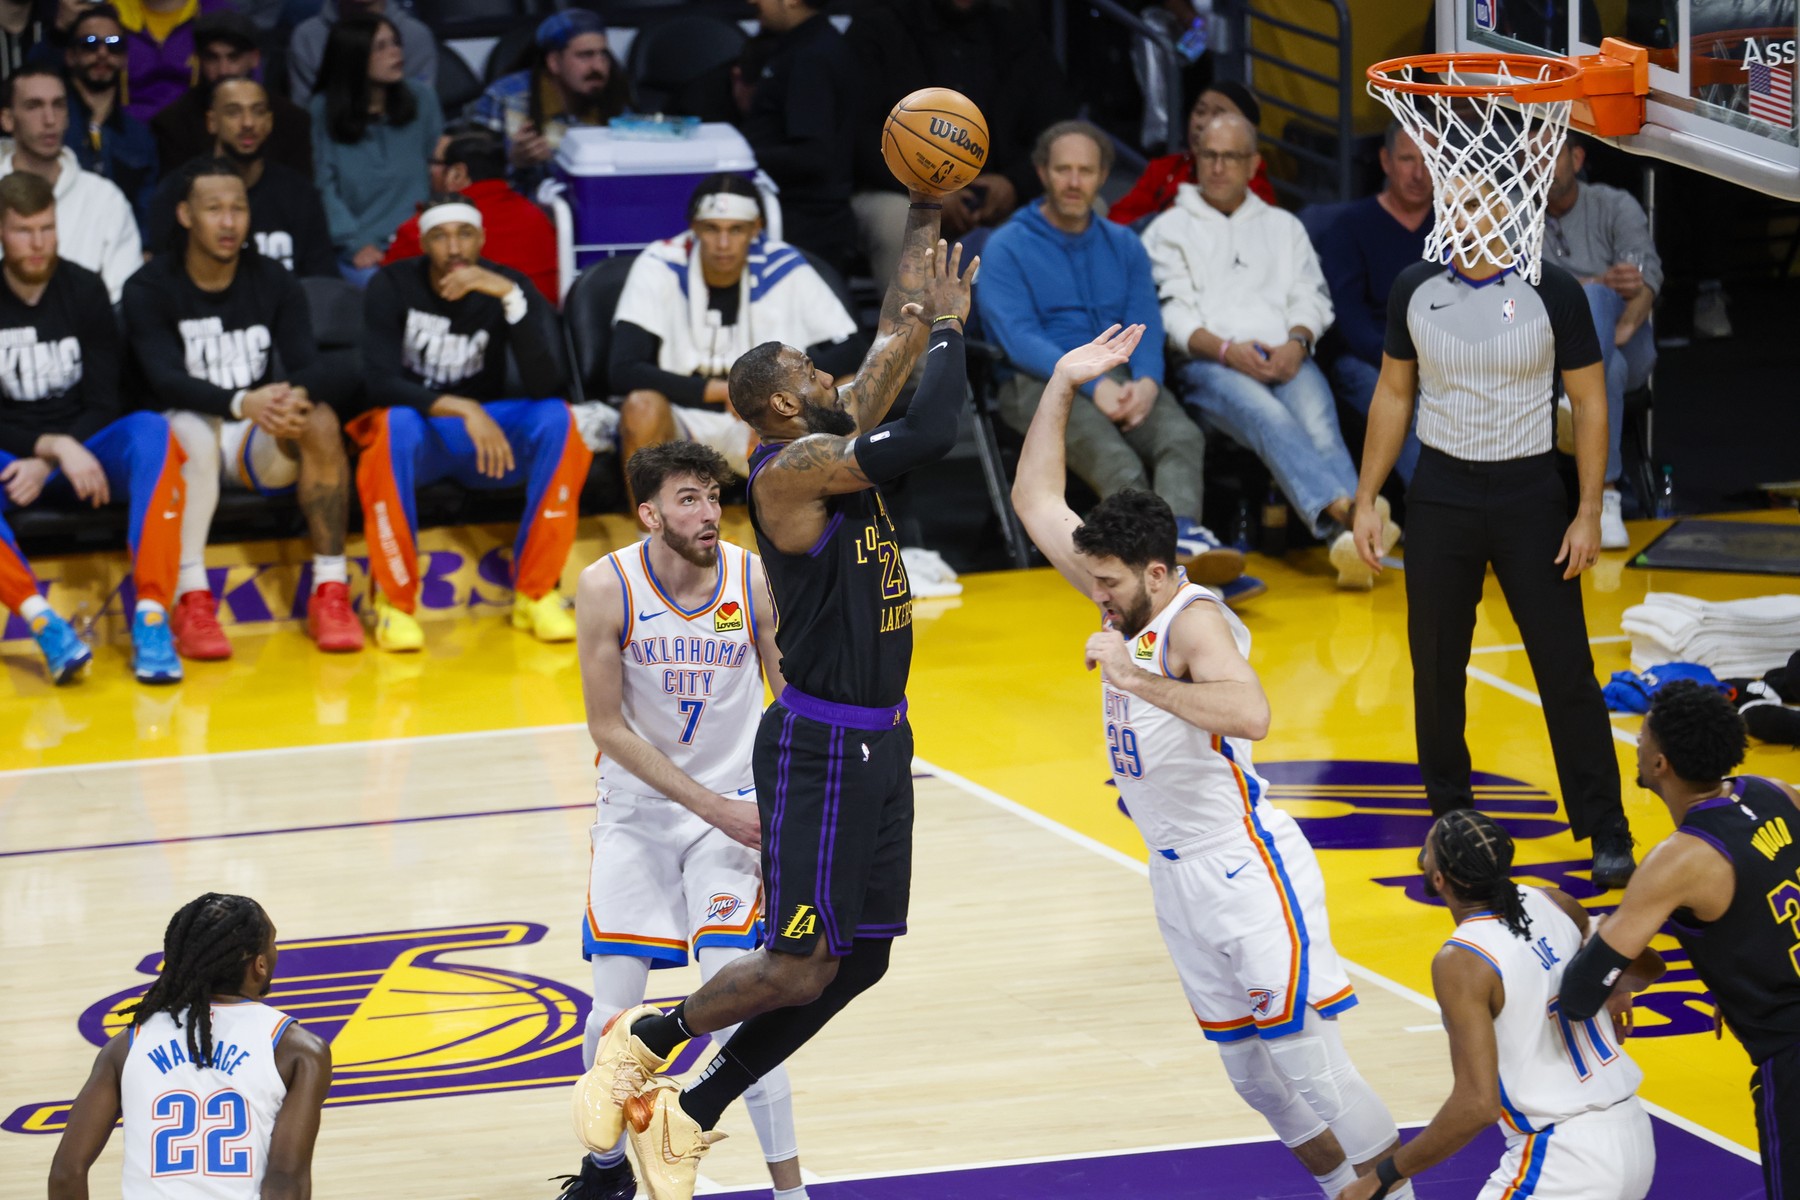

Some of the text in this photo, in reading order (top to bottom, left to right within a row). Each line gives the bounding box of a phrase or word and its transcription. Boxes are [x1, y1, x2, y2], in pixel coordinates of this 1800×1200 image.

[930, 117, 985, 161] Wilson
[855, 515, 880, 564] LO
[716, 619, 741, 629] Love's
[630, 636, 749, 668] OKLAHOMA
[662, 668, 715, 696] CITY
[678, 698, 706, 745] 7
[1107, 720, 1145, 780] 29
[1750, 816, 1792, 861] WOOD
[781, 904, 817, 939] LA
[147, 1039, 250, 1076] WAACE
[151, 1087, 252, 1178] 22
